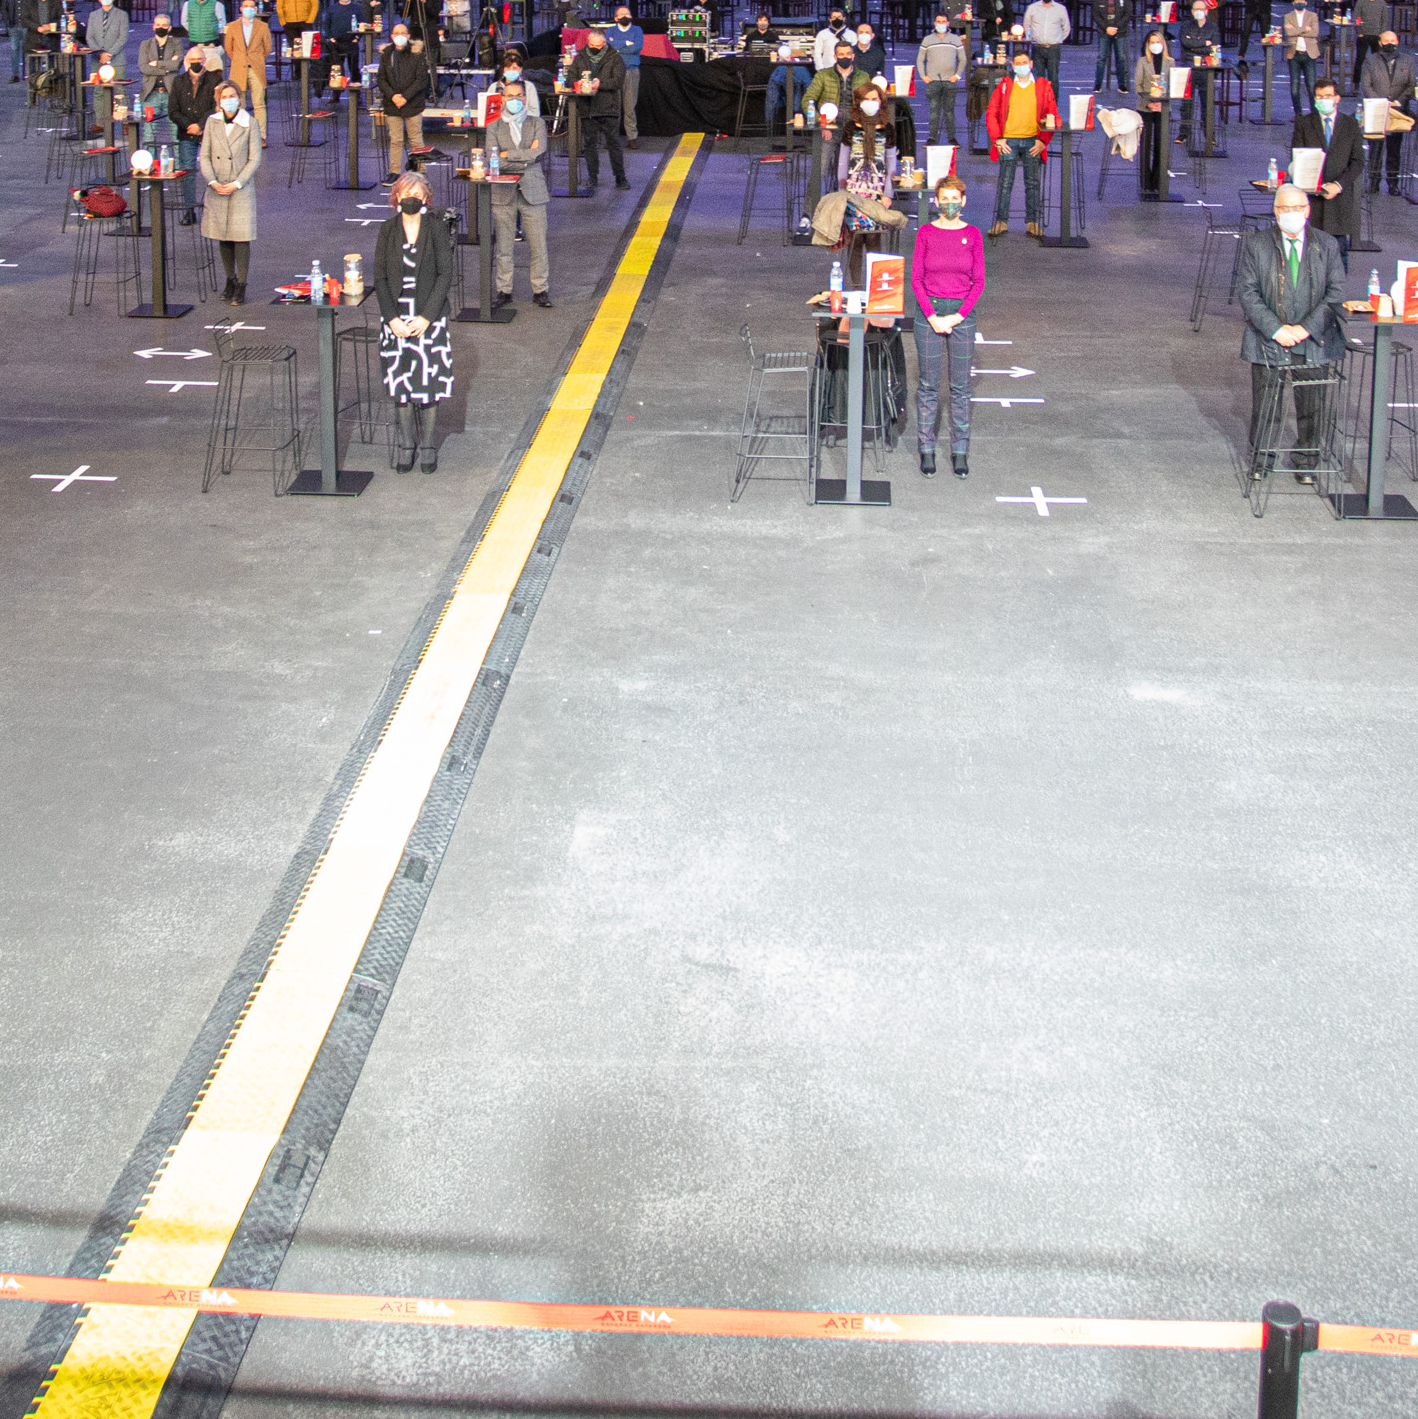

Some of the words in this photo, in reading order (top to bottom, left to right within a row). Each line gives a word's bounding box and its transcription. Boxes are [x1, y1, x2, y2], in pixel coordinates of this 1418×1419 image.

[156, 1288, 239, 1305] ARENA
[374, 1299, 456, 1317] ARENA
[593, 1310, 677, 1324] ARENA
[816, 1316, 902, 1332] ARENA
